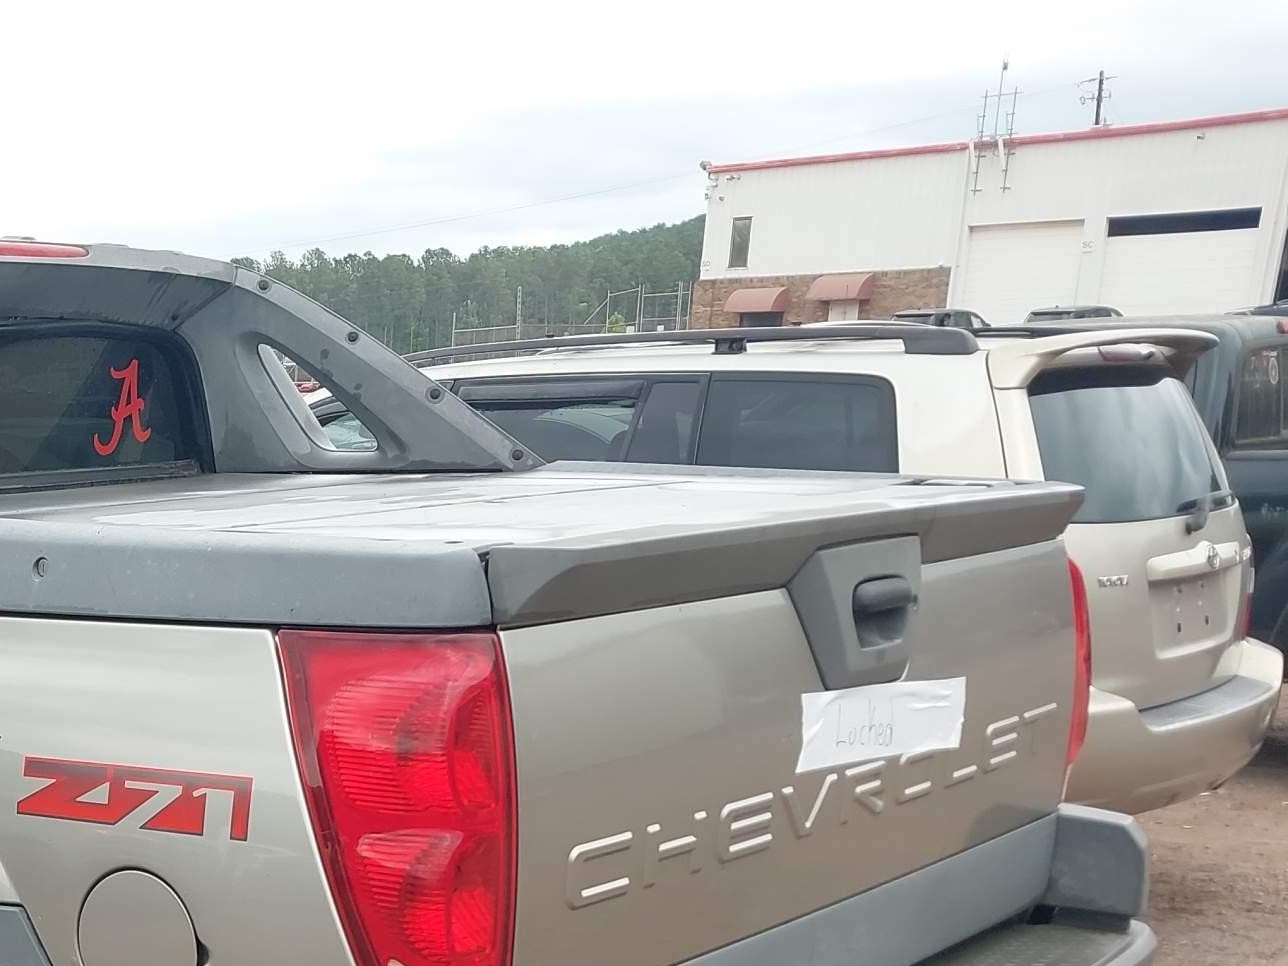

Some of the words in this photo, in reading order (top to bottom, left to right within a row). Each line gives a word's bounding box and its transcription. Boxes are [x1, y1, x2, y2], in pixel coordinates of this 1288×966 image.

[93, 359, 152, 456] A
[16, 755, 255, 842] Z71
[566, 702, 1059, 909] CHEVROLET
